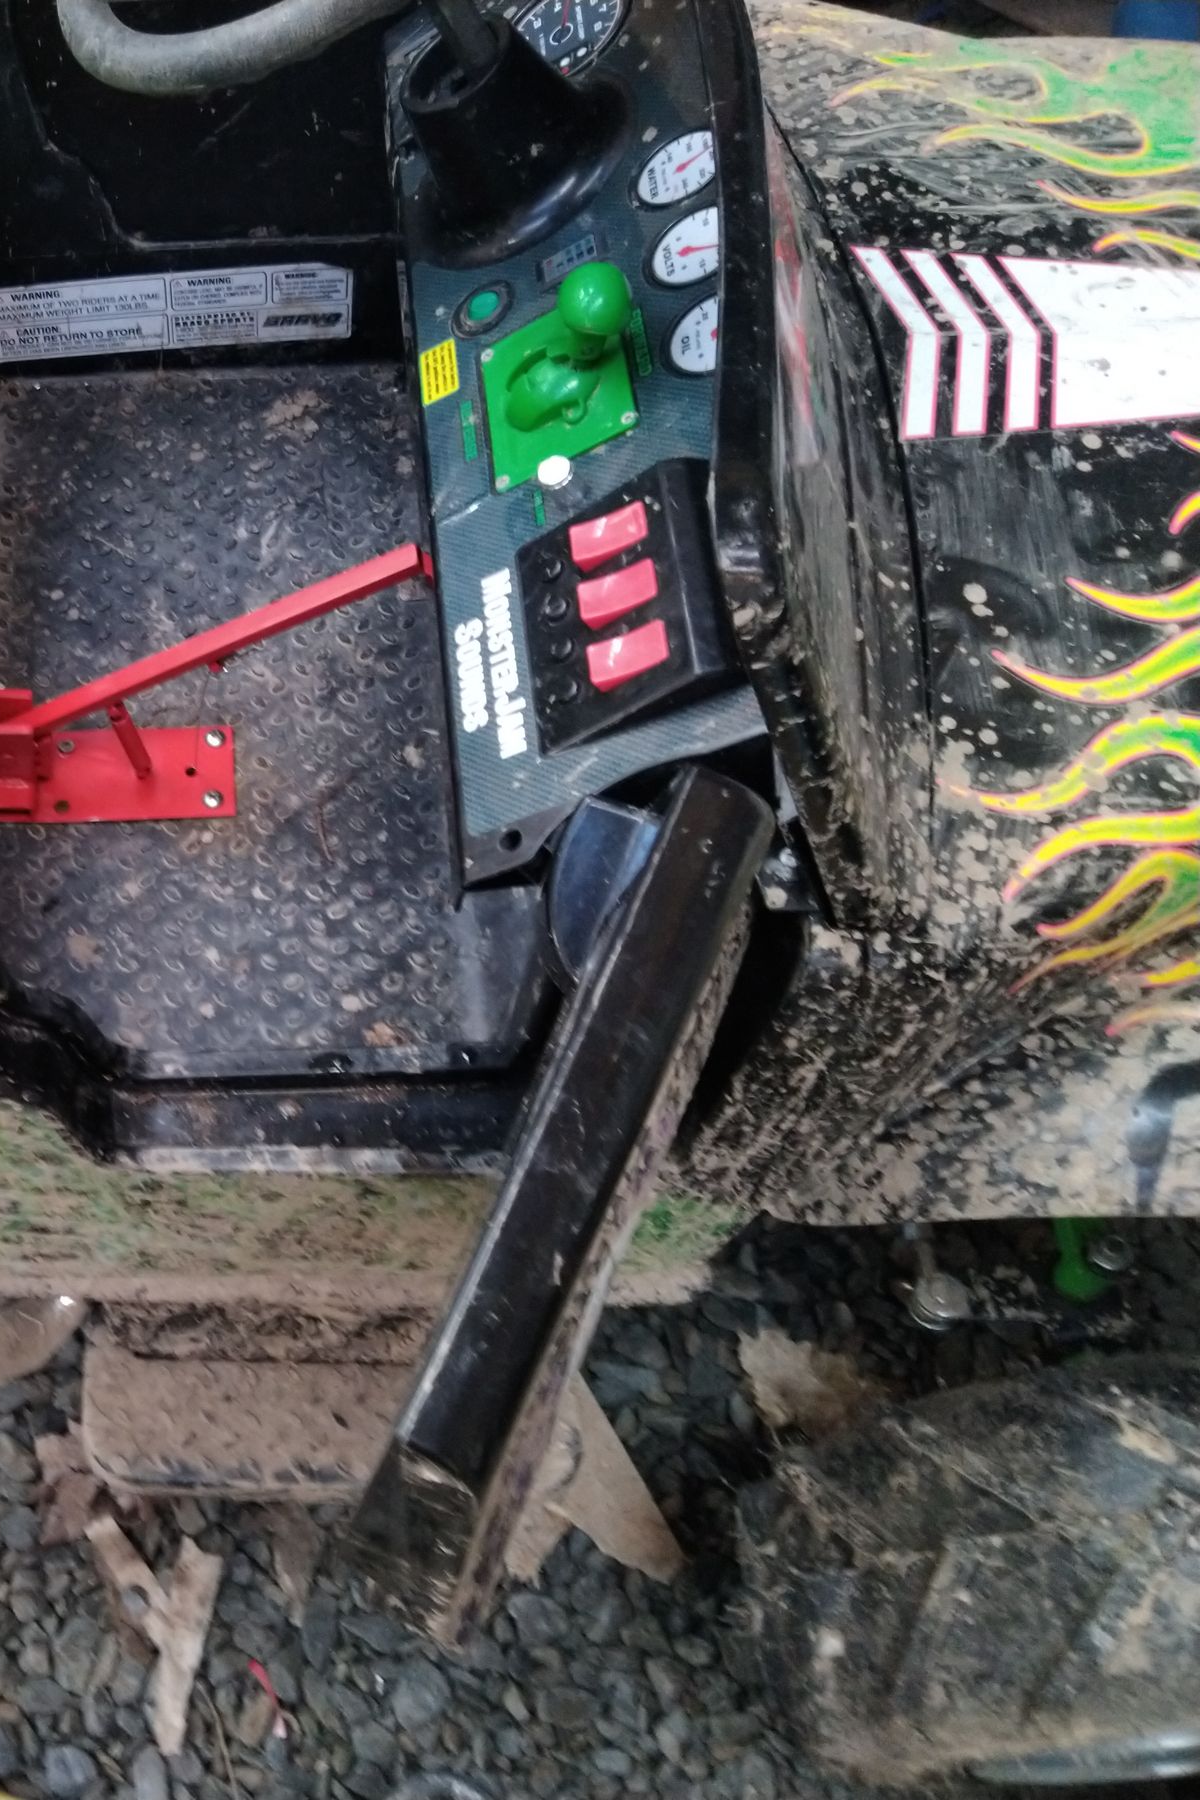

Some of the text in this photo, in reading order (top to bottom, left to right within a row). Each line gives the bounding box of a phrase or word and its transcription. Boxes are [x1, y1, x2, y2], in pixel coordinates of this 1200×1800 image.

[647, 166, 659, 200] WATER
[662, 243, 676, 277] VOLTS
[0, 337, 16, 346] DO
[18, 336, 40, 345] NOT
[43, 331, 88, 344] RETURN
[90, 329, 106, 339] TO
[681, 335, 692, 355] OIL
[454, 617, 489, 733] SOUNDS
[481, 567, 527, 760] MONSTER JAM
